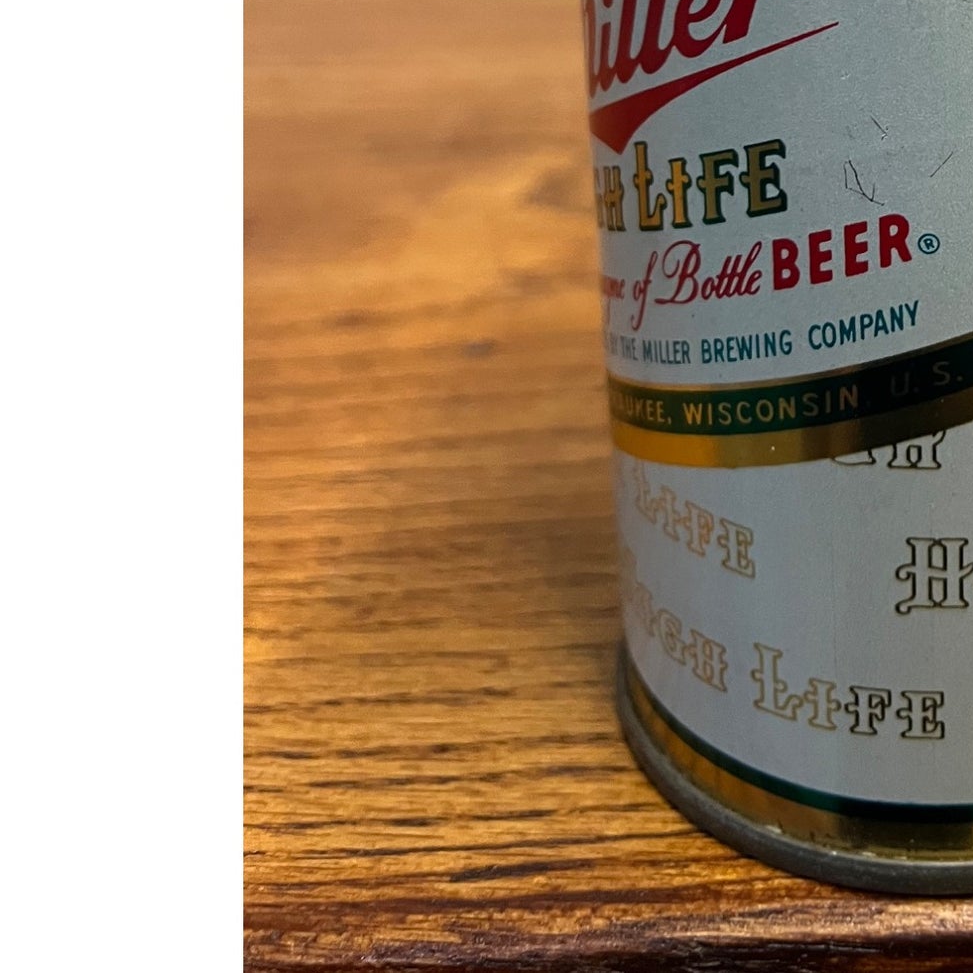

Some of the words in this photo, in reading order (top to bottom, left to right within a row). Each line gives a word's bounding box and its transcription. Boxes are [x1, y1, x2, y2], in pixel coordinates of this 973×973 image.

[633, 139, 787, 232] LIFE
[630, 250, 659, 332] of
[654, 240, 763, 305] Bottle
[771, 213, 913, 291] BEER
[620, 335, 638, 361] THE
[642, 339, 691, 365] MILLER
[701, 329, 793, 365] BREWING
[808, 300, 920, 351] COMPANY
[750, 641, 947, 740] LIFE
